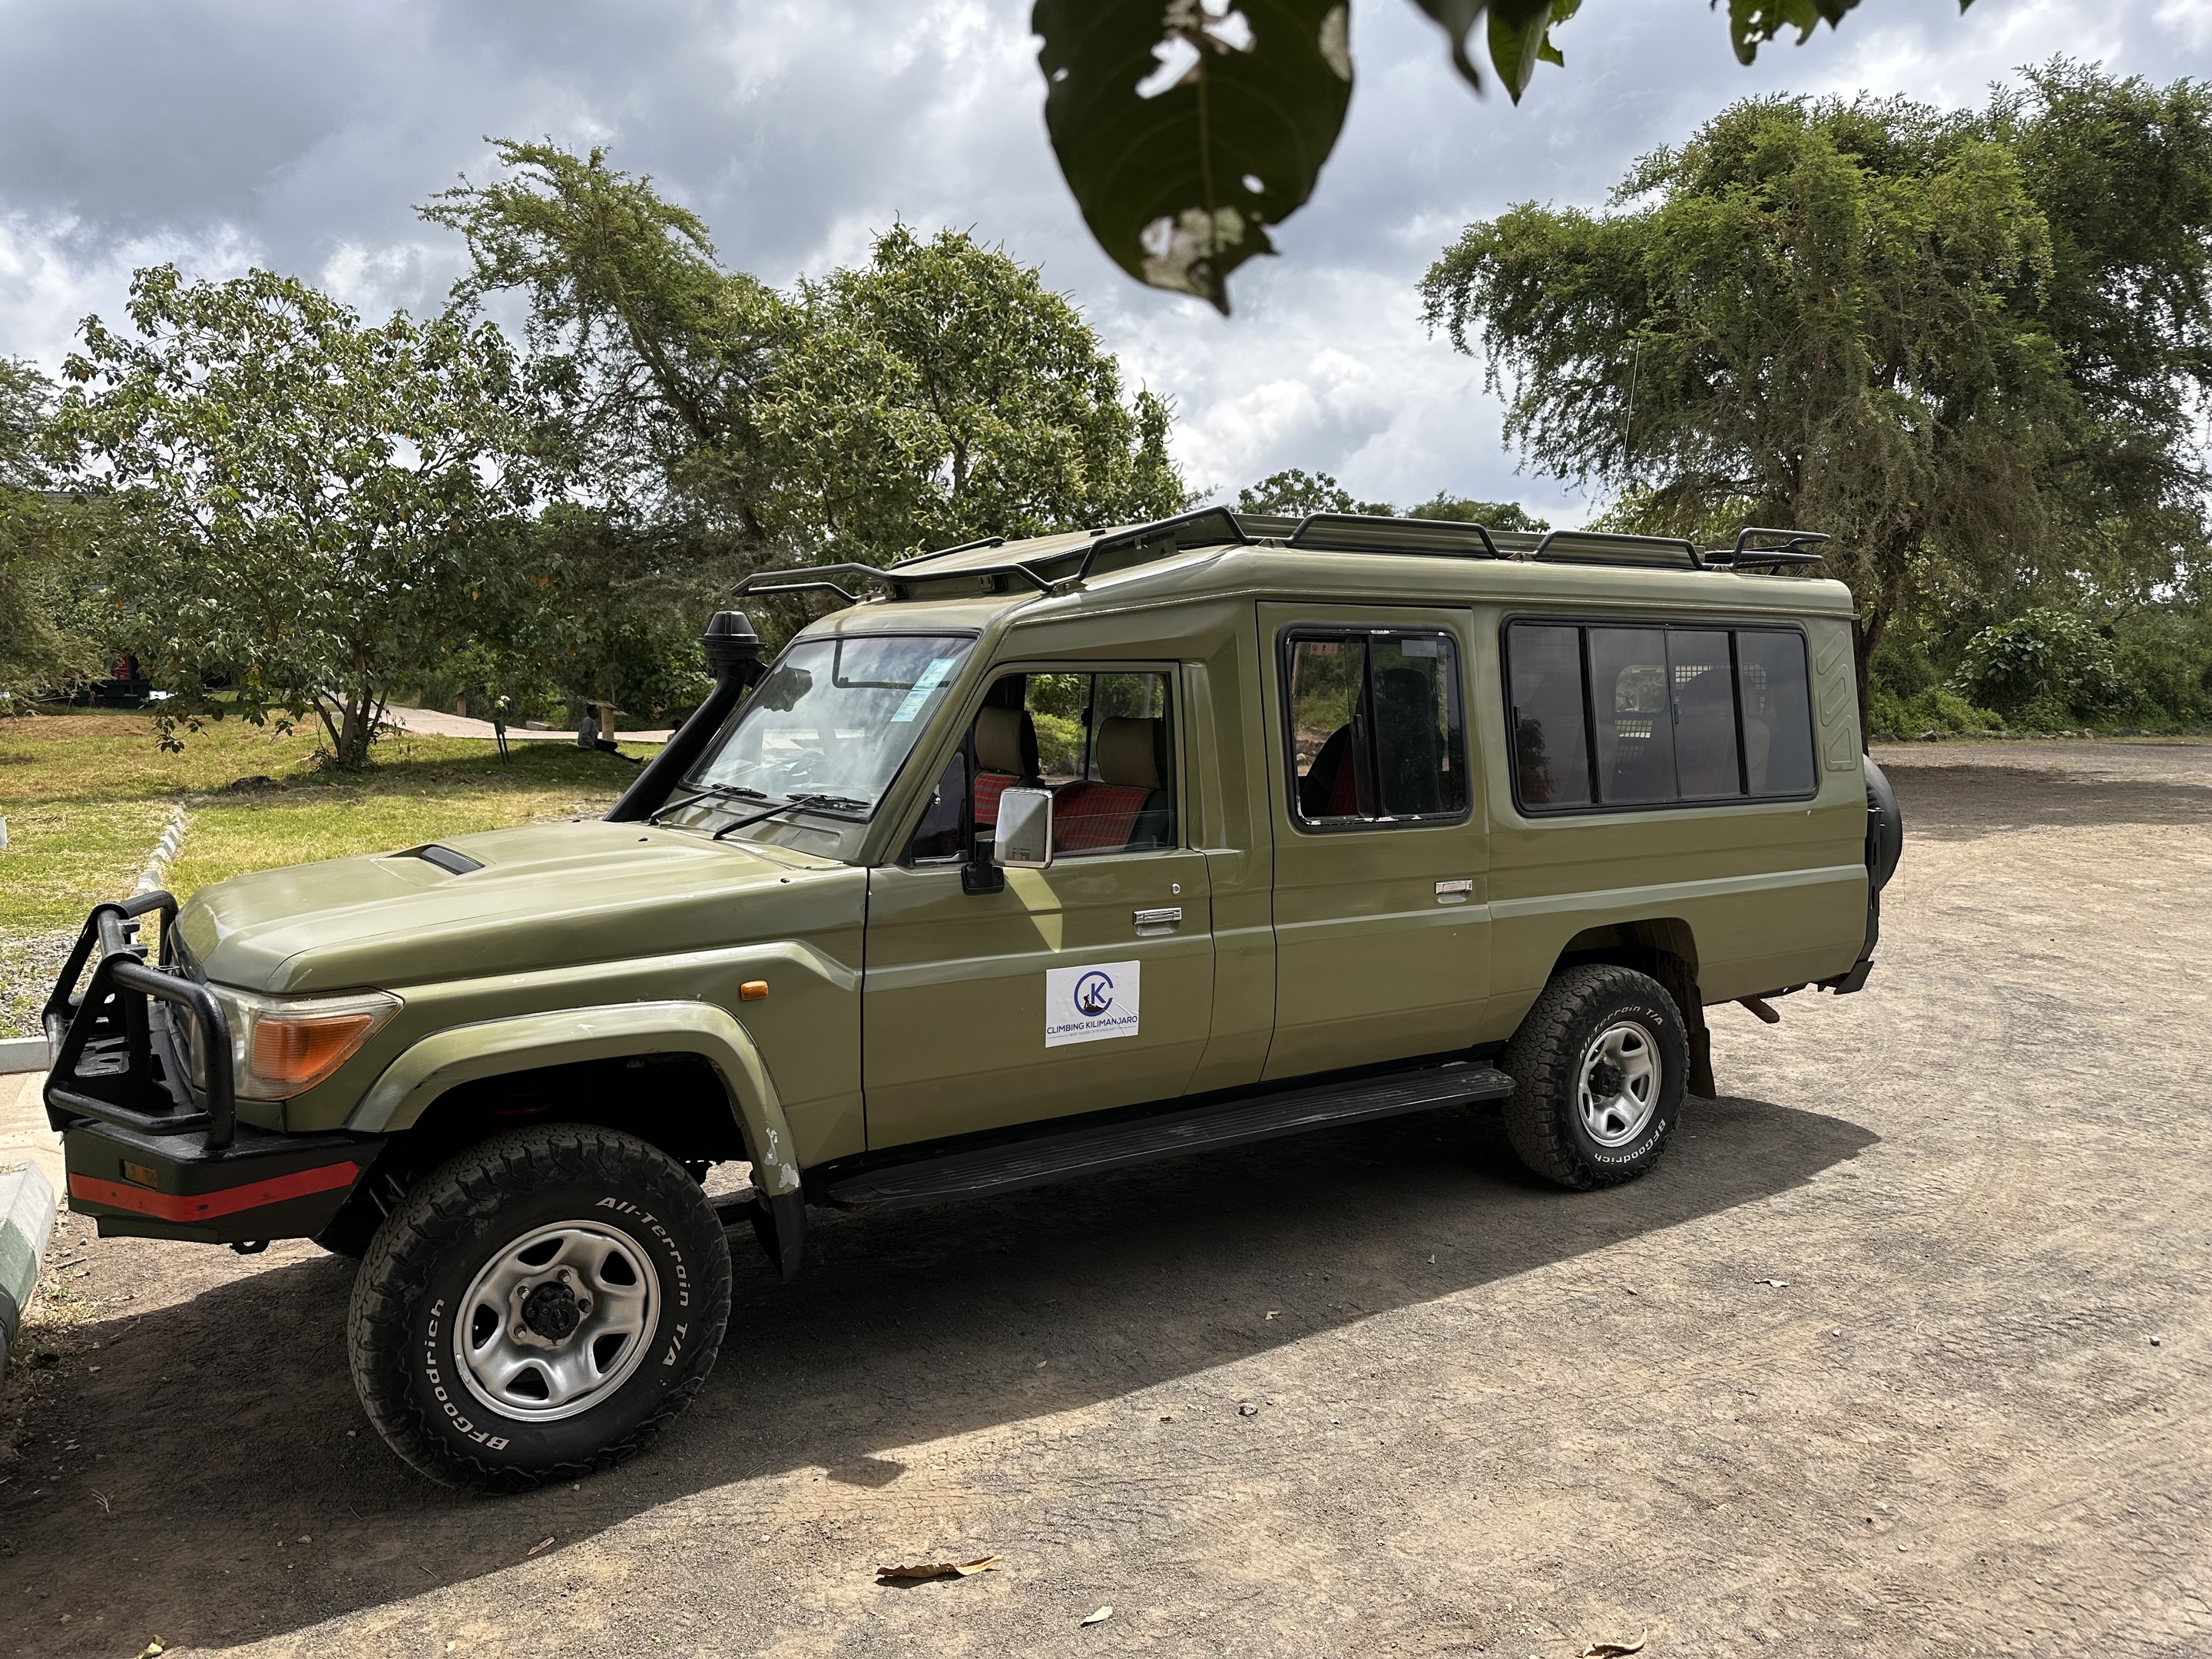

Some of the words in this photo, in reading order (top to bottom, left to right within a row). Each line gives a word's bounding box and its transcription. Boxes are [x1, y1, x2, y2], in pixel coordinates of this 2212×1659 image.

[1047, 1022, 1084, 1035] CLIMBING
[1085, 1015, 1138, 1029] KILIMANJARO
[1580, 1005, 1641, 1061] All-Terrain
[1646, 1008, 1664, 1025] T/A
[1594, 1118, 1667, 1165] BFGoodrich
[595, 1197, 690, 1307] All-Terrain
[662, 1323, 688, 1366] T/A
[425, 1299, 510, 1451] BFGoodrich
